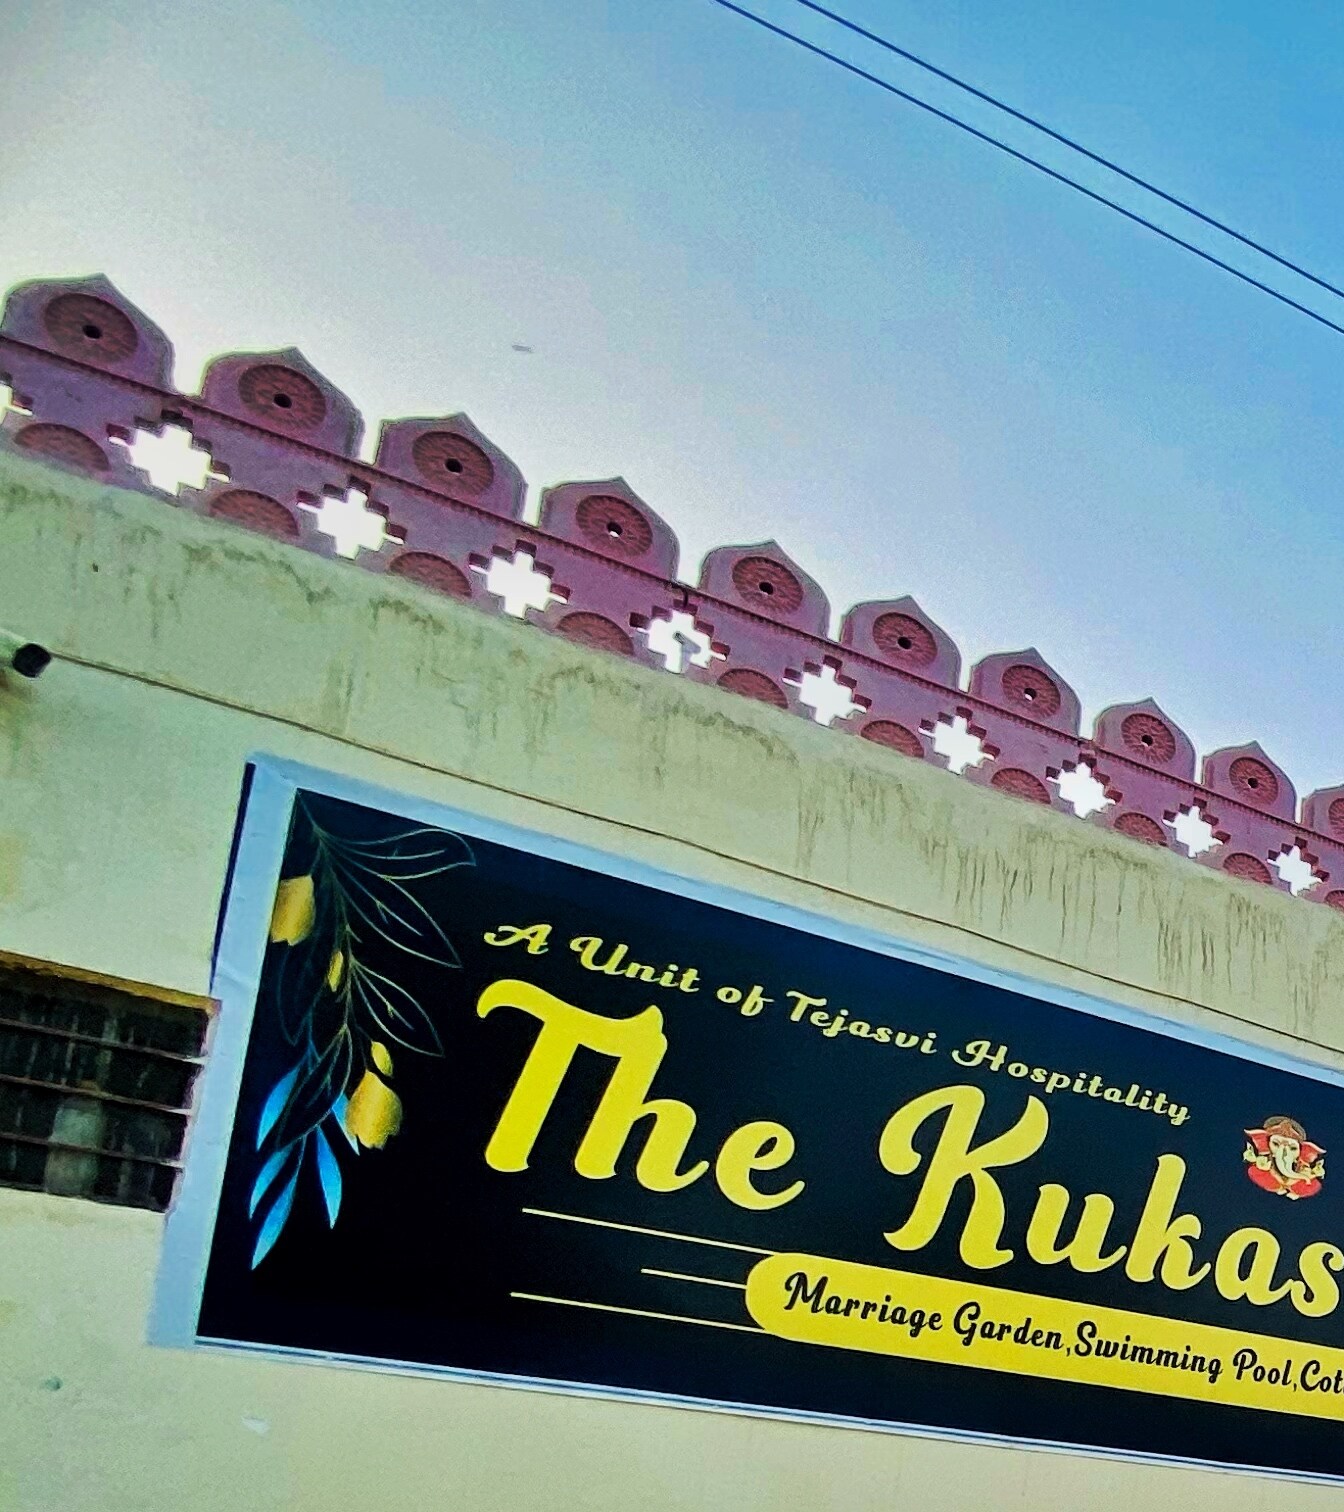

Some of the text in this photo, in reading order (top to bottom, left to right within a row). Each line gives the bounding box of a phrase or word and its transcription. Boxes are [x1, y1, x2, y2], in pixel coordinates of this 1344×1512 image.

[475, 978, 806, 1211] The
[483, 923, 1192, 1126] A Unit of Tejasvi Hospitality
[783, 1270, 944, 1338] Marriage
